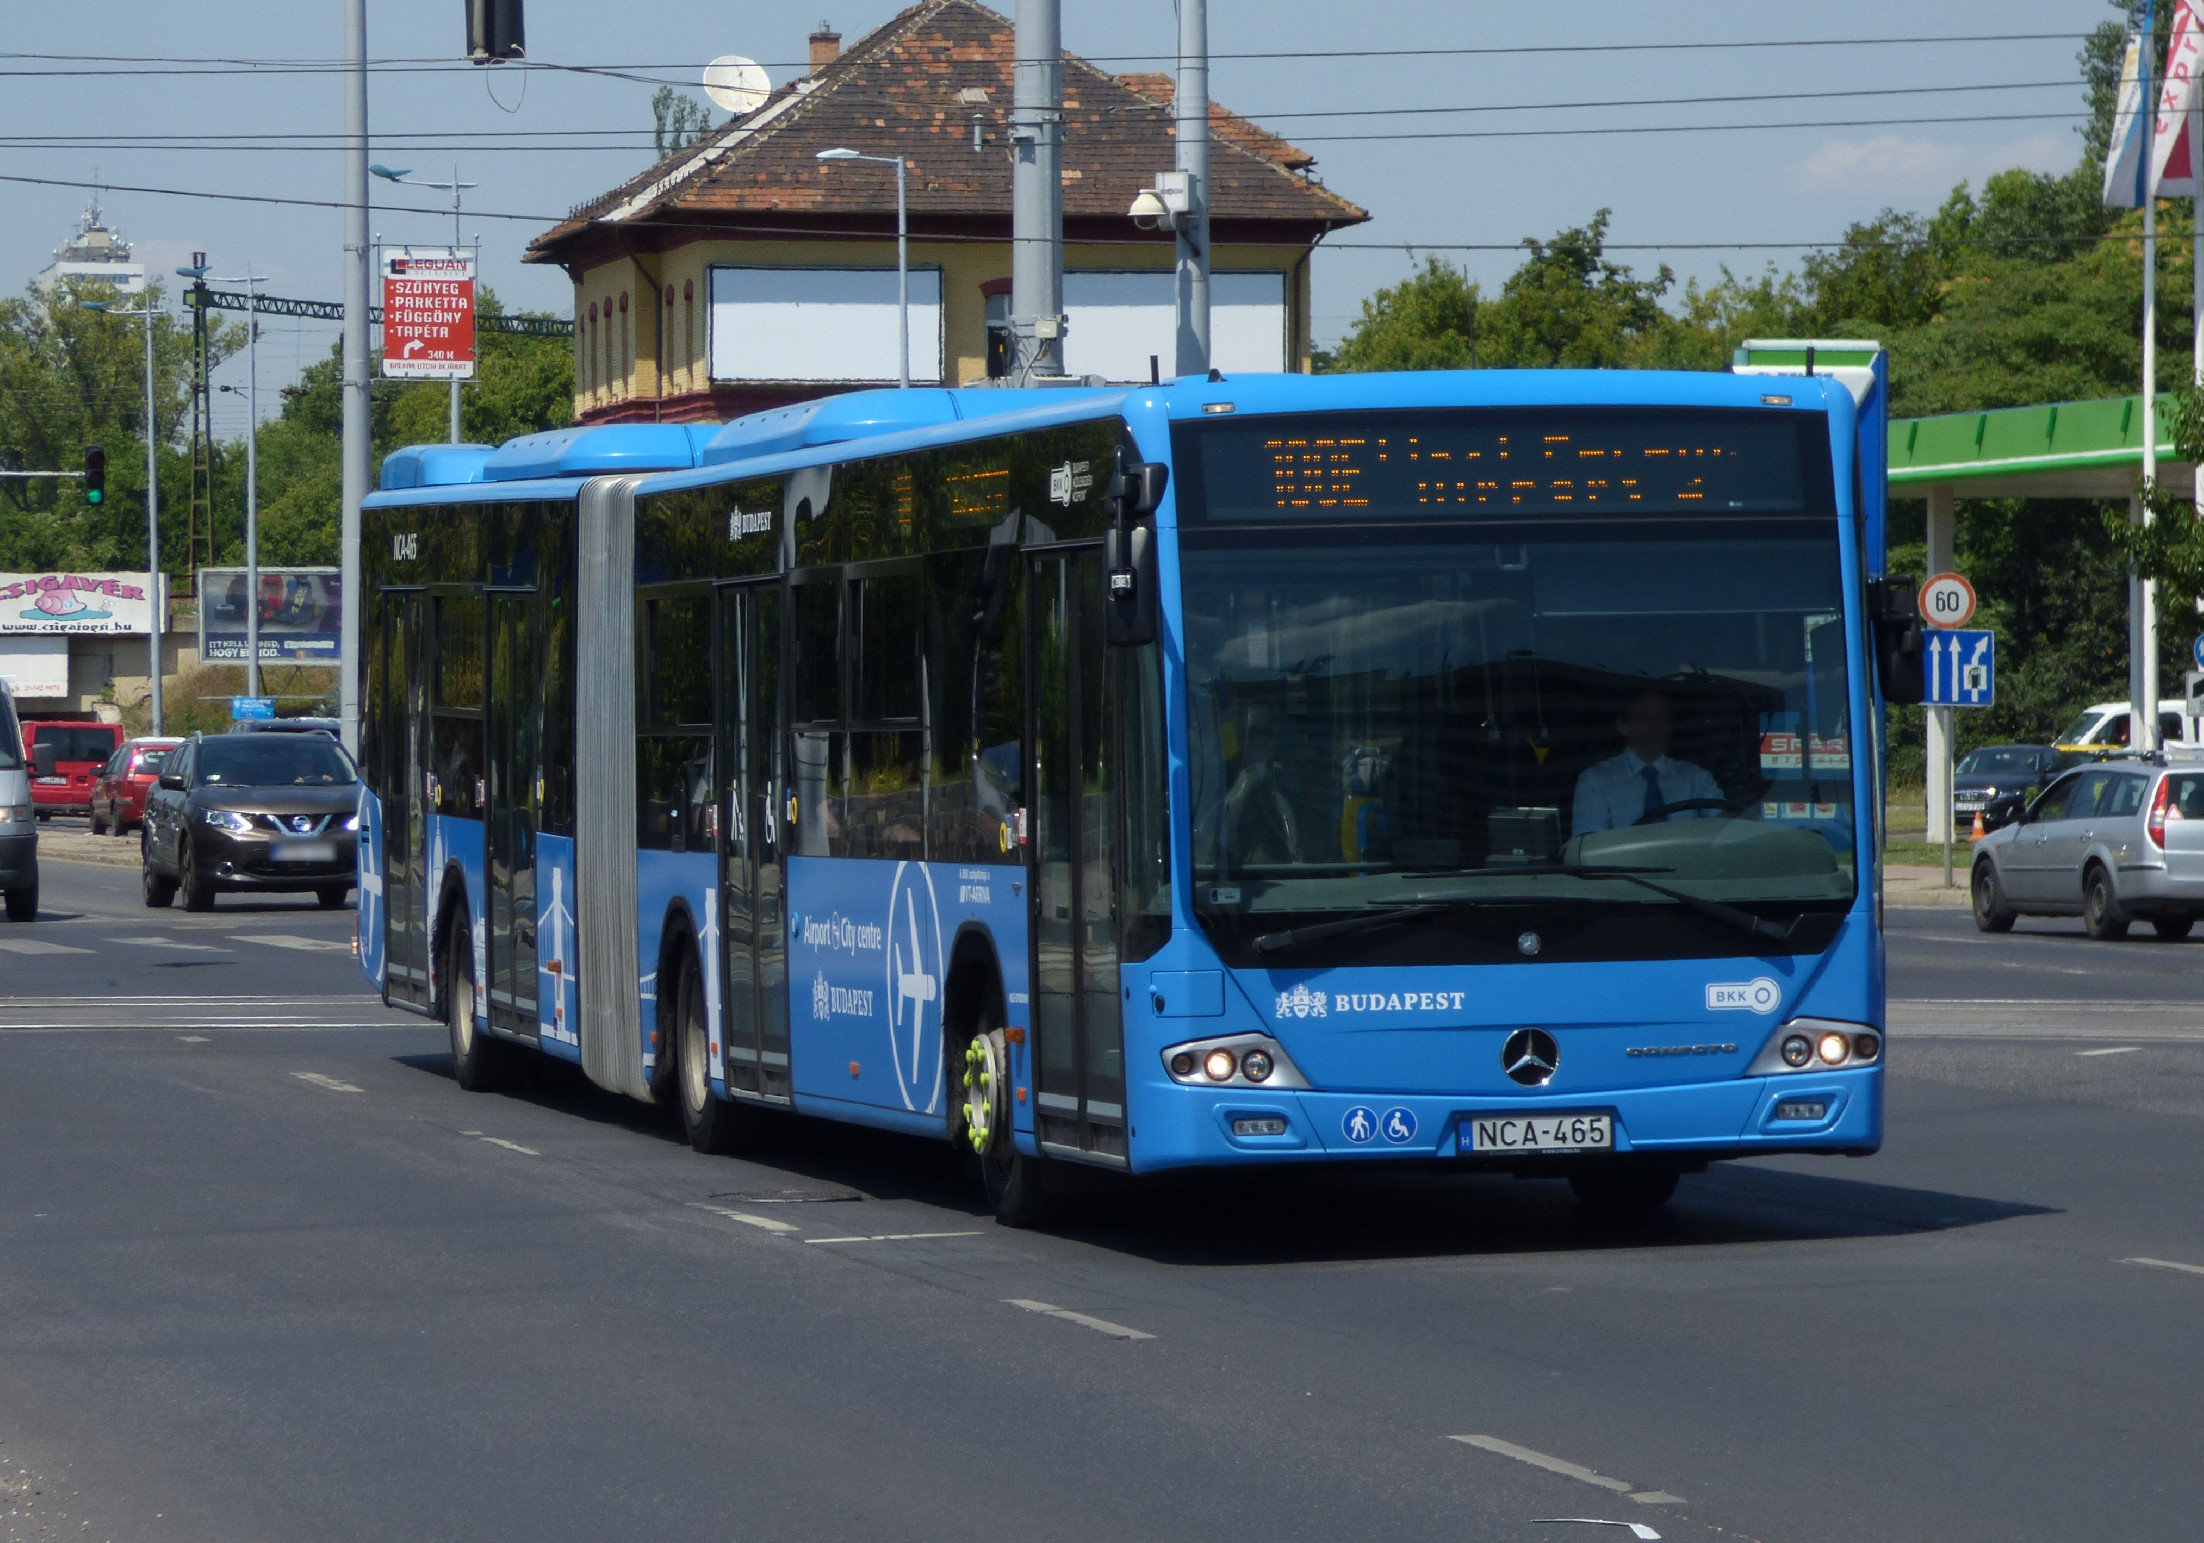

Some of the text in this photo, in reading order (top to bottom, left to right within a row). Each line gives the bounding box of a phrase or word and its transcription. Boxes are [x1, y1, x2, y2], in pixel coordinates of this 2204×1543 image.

[407, 259, 467, 270] LEGUAN
[395, 296, 468, 309] PARKETTA
[395, 310, 462, 323] FÜGGÖNY
[395, 325, 449, 338] TAPÉTA
[428, 350, 445, 359] 340
[742, 511, 772, 534] BUDAPEST
[1935, 591, 1960, 612] 60
[209, 648, 238, 658] HOGY
[803, 914, 882, 957] Airport City centre
[830, 986, 874, 1017] BUDAPEST
[1335, 992, 1465, 1012] BUDAPEST
[1716, 990, 1748, 1003] BKK
[1461, 1118, 1605, 1148] H NCA-465
